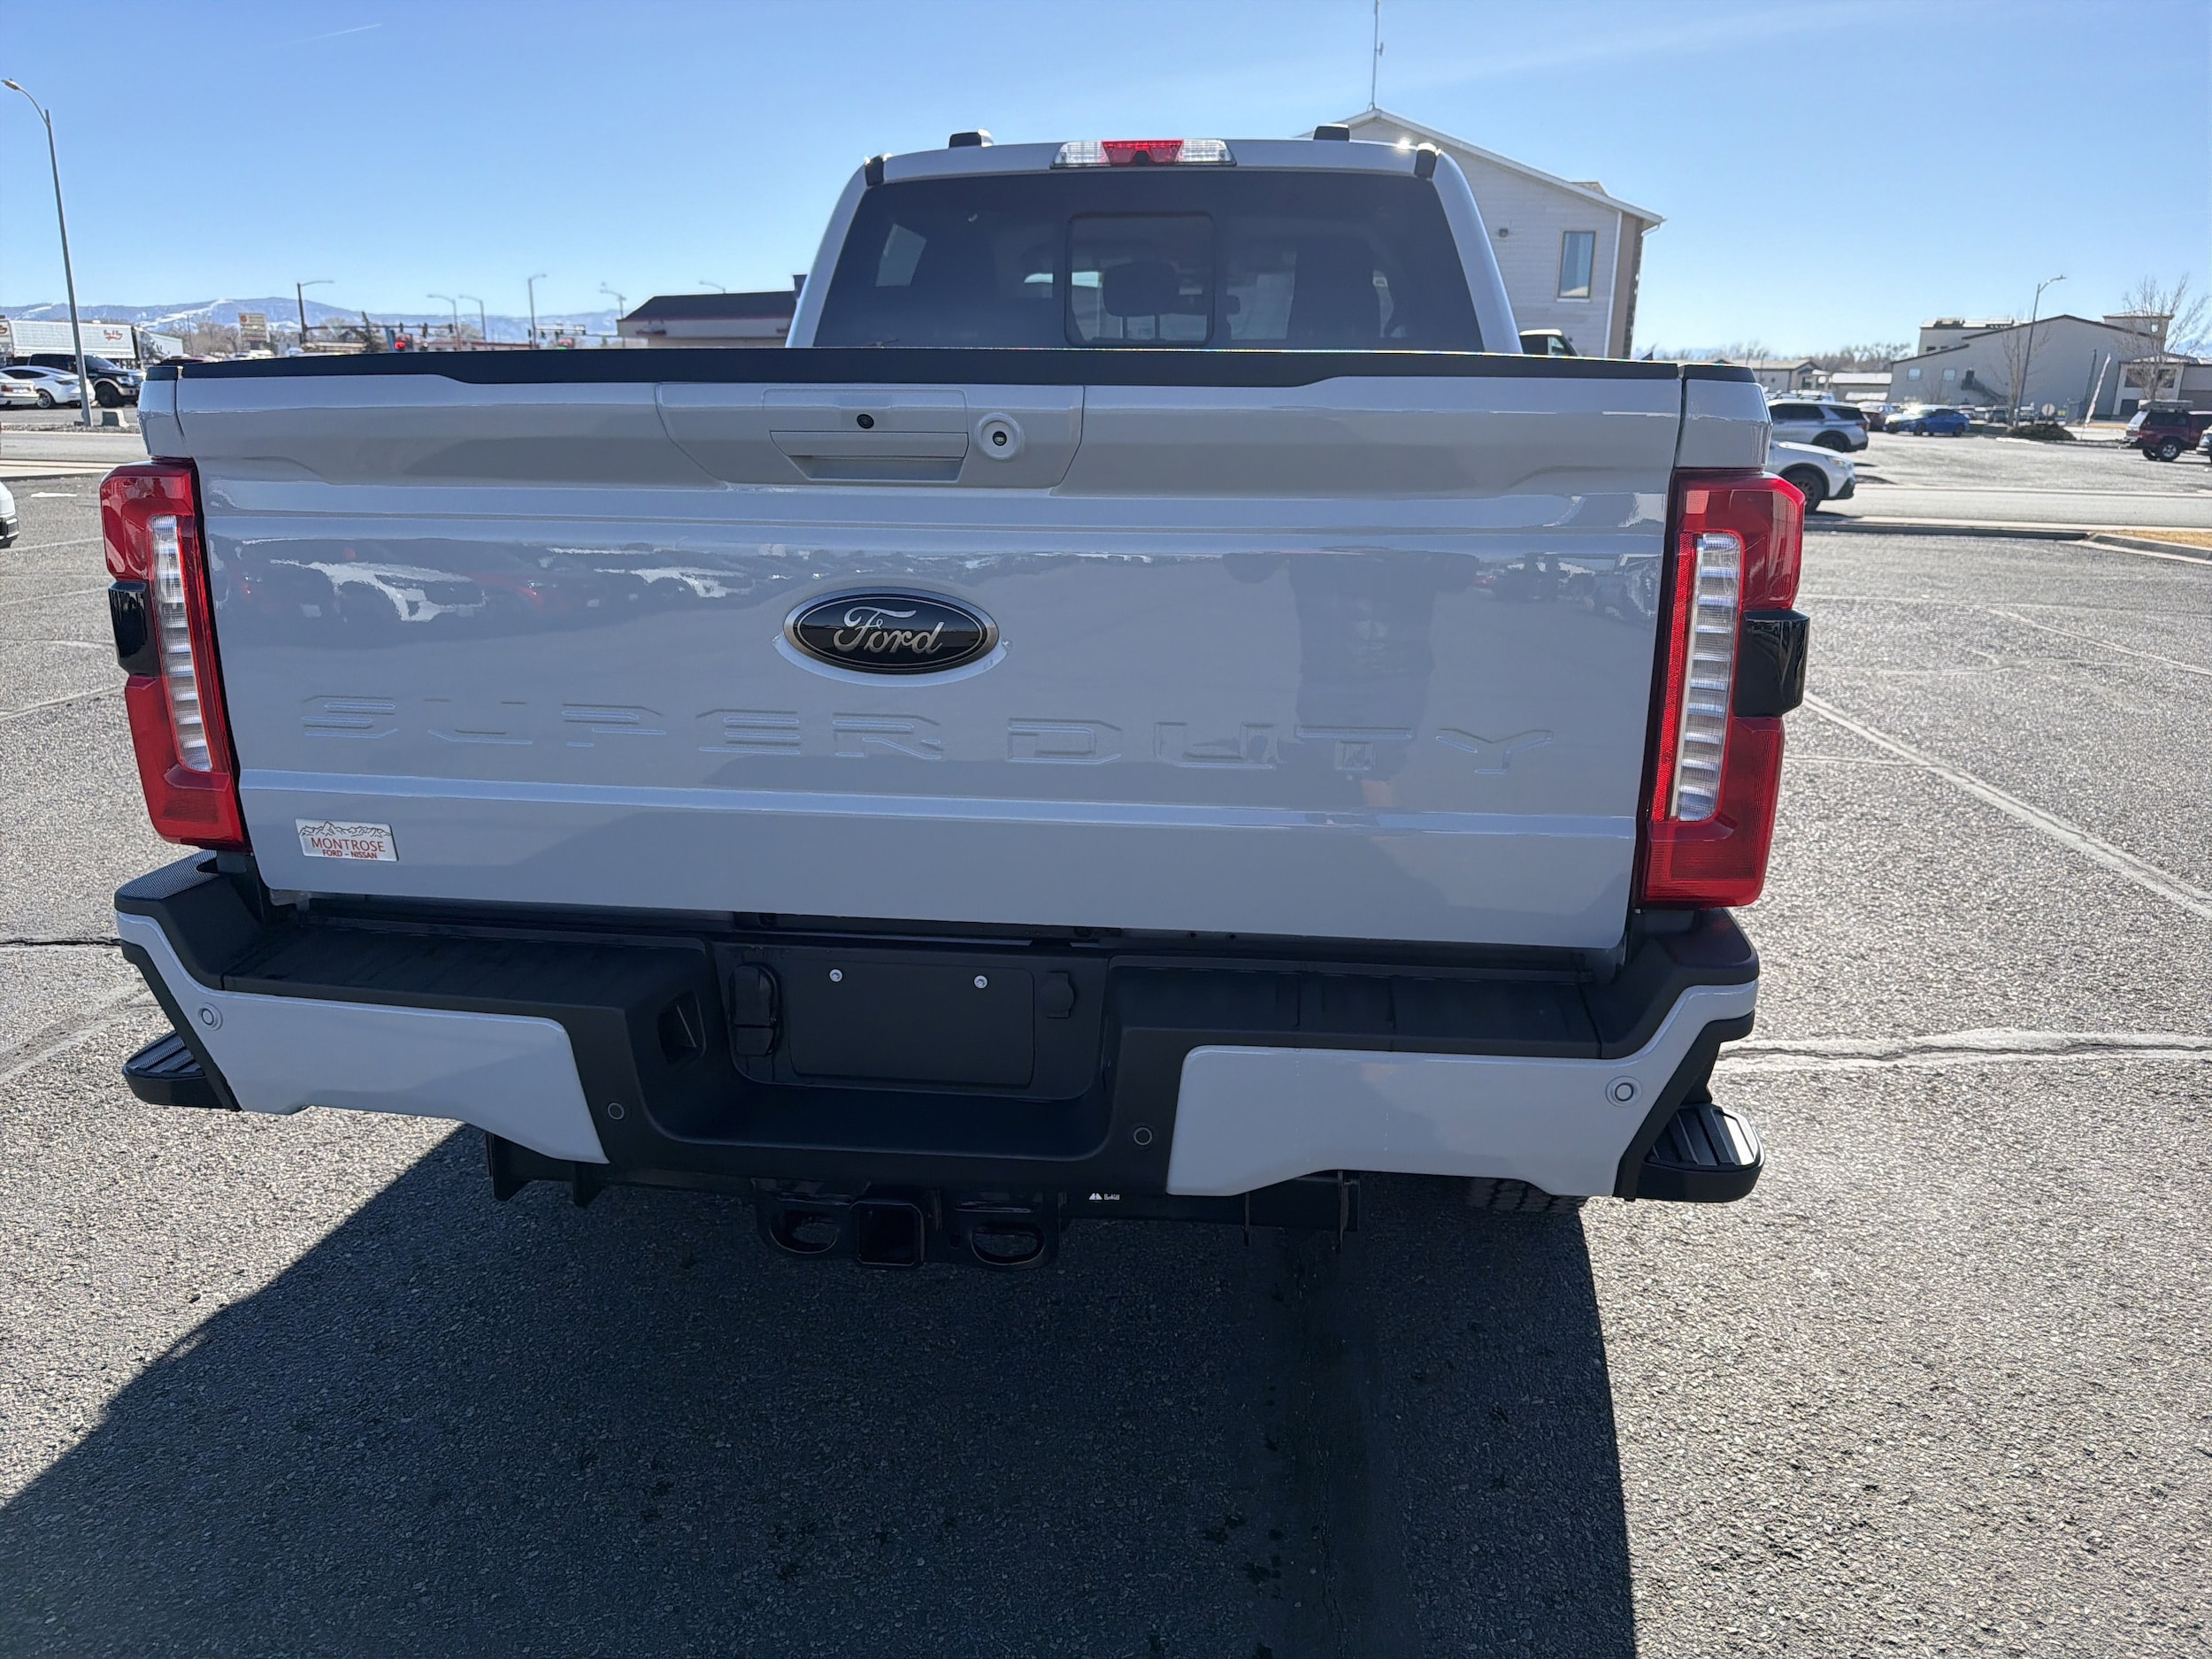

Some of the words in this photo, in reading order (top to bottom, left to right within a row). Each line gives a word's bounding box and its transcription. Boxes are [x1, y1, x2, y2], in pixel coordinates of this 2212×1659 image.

[833, 606, 944, 654] Ford
[301, 695, 944, 760] SUPER
[1007, 717, 1554, 774] DUTY
[311, 837, 386, 852] MONTROSE
